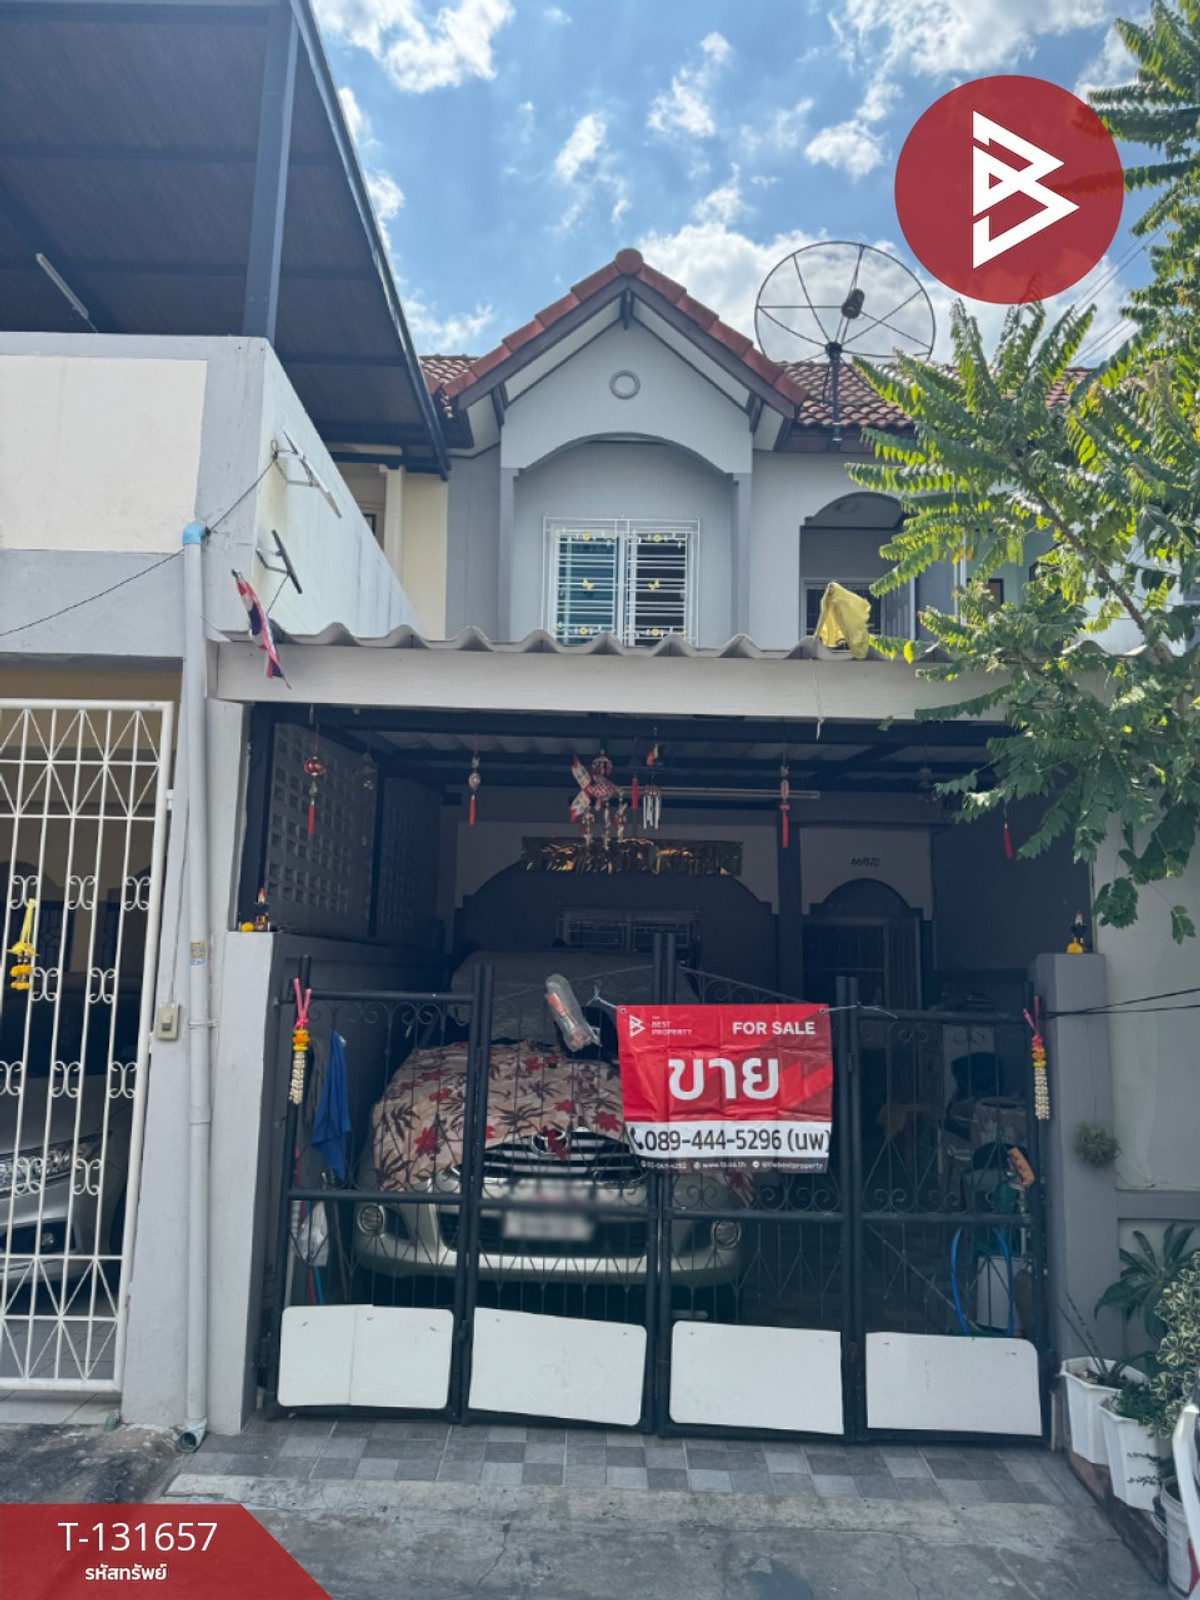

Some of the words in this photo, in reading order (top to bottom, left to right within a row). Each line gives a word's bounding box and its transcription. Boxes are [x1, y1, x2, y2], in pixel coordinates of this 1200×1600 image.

[732, 1021, 767, 1035] FOR
[772, 1021, 816, 1035] SALE
[668, 1057, 779, 1101] ขาย
[644, 1129, 782, 1151] 089-444-5296
